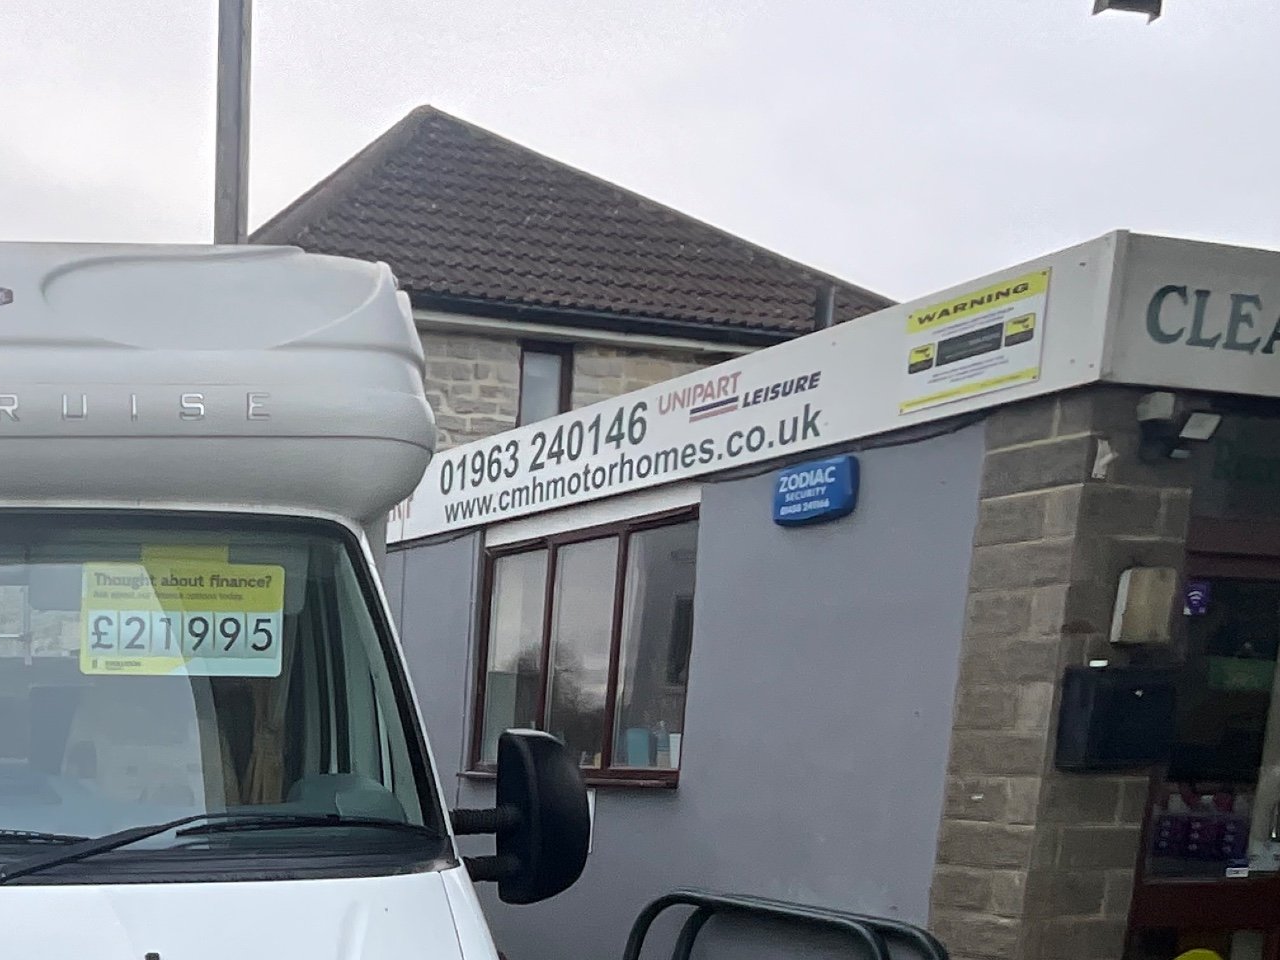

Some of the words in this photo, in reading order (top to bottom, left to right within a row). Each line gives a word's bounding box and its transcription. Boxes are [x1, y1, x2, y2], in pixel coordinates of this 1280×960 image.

[917, 282, 1029, 325] WARNING
[658, 371, 742, 415] UNIPART
[741, 371, 822, 408] LEISURE
[440, 440, 520, 496] 01963
[528, 401, 648, 473] 240146
[444, 403, 823, 524] www.cmhmotorhomes.co.uk
[778, 466, 836, 493] ZODIAC
[784, 486, 827, 502] SECURITY
[94, 572, 156, 590] Thought
[161, 575, 204, 588] about
[209, 574, 273, 588] finance?
[91, 615, 273, 652] £21995
